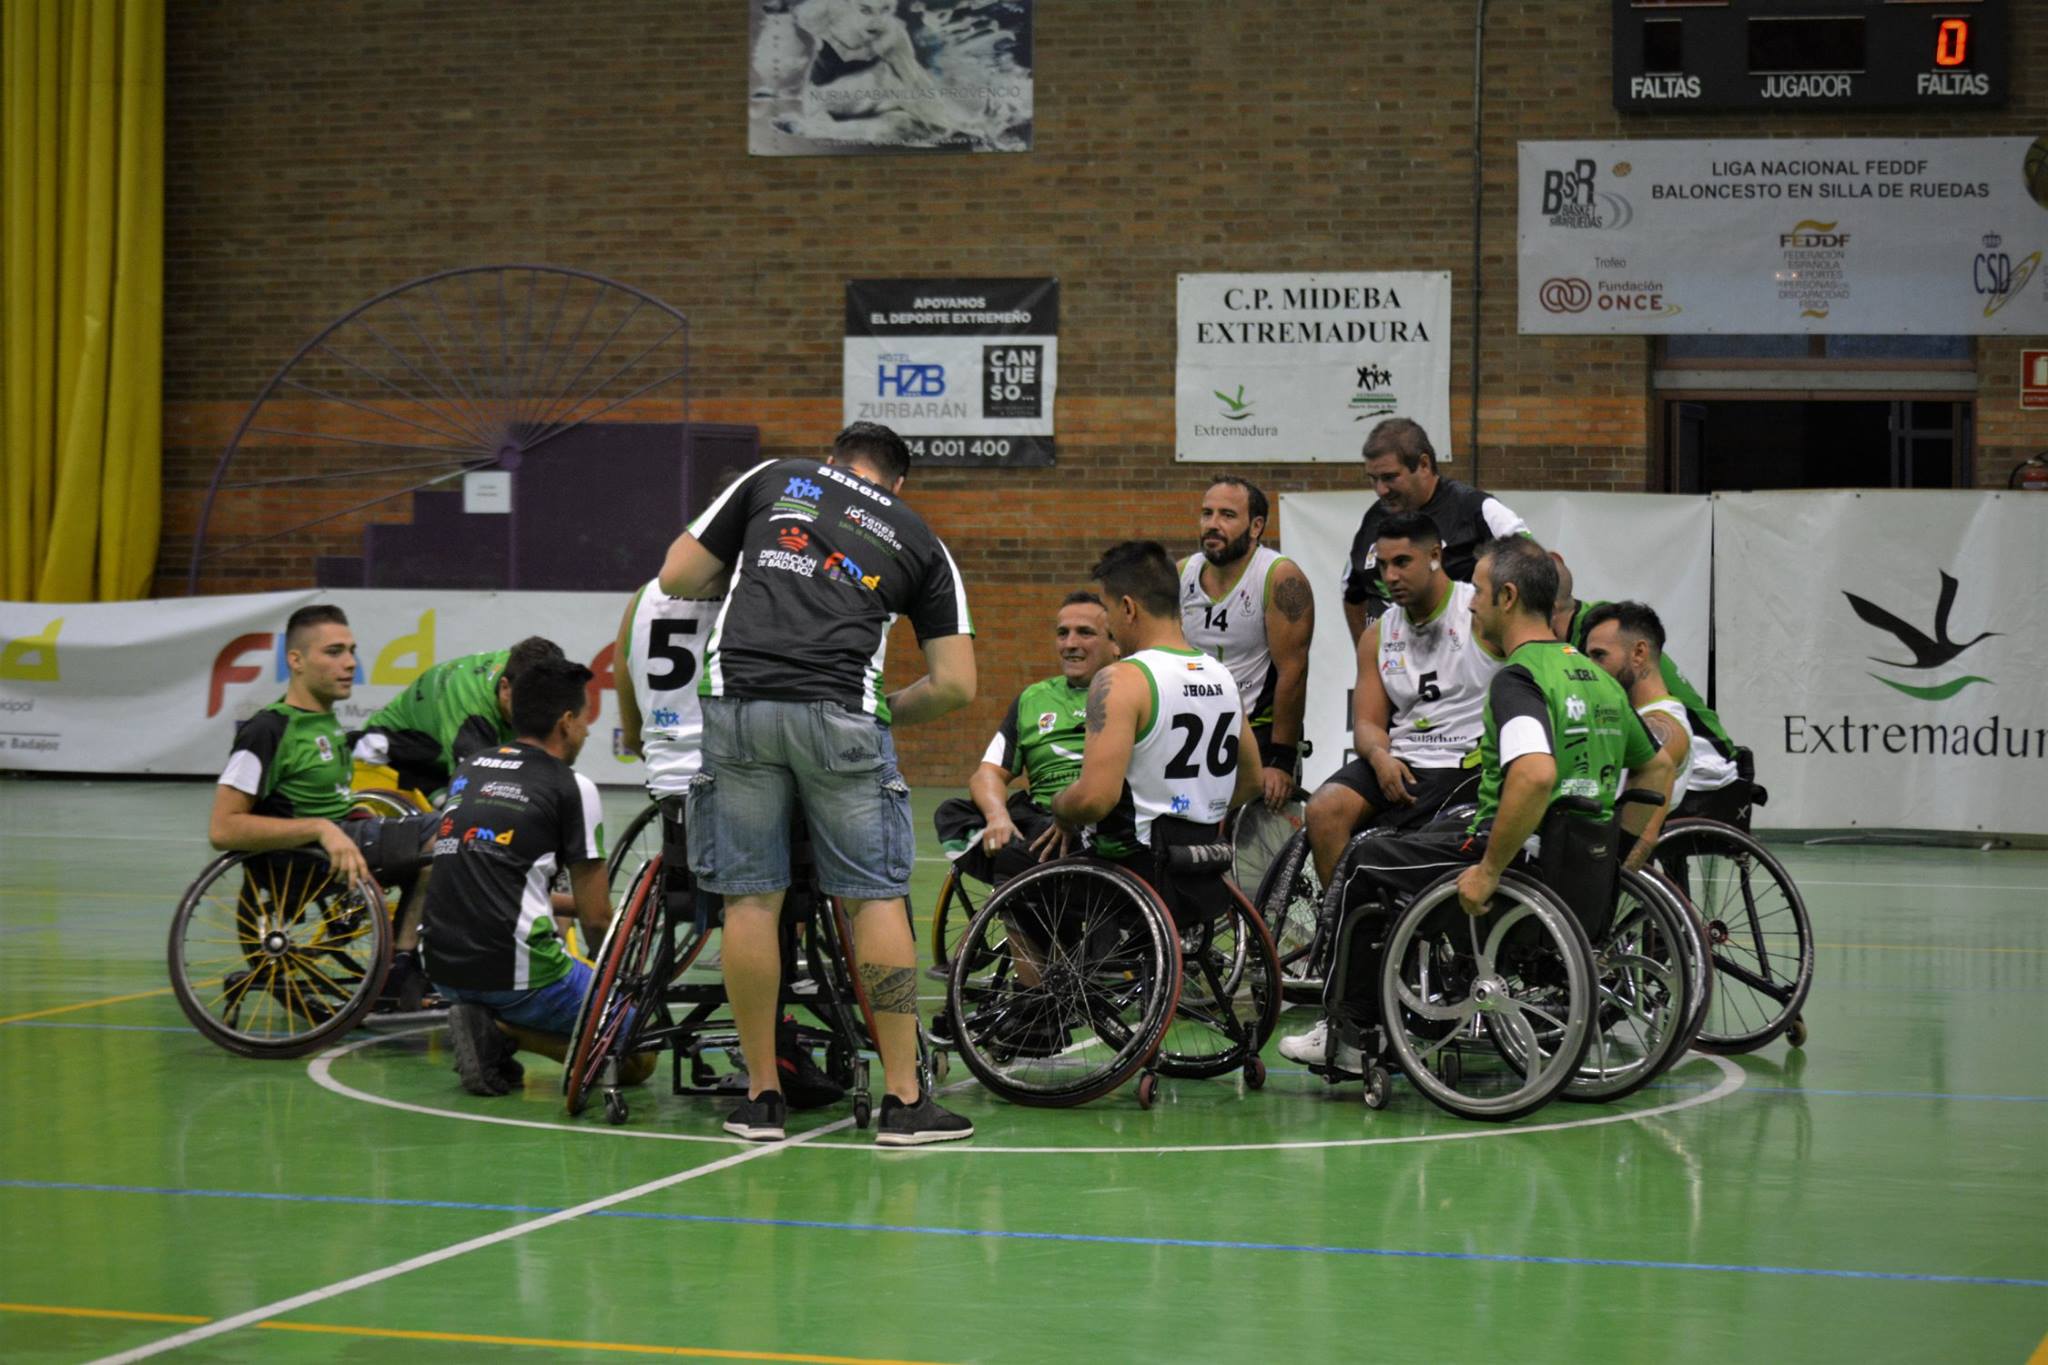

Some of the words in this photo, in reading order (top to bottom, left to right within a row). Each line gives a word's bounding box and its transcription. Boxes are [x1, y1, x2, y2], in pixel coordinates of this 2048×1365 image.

[1936, 19, 1968, 66] 0
[1631, 76, 1701, 99] FALTAS
[1761, 75, 1851, 98] JUGADOR
[1917, 73, 1989, 96] FALTAS
[1712, 162, 1756, 176] LIGA
[1761, 161, 1859, 176] NACIONAL
[1865, 160, 1928, 175] FEDDF
[1652, 184, 1782, 199] BALONCESTO
[1787, 184, 1813, 199] EN
[1819, 183, 1872, 199] SILLA
[1878, 183, 1903, 198] DE
[1910, 182, 1990, 198] RUEDAS
[1780, 233, 1850, 248] FEDDF
[1595, 257, 1626, 269] Trofeo
[1974, 253, 2011, 294] CSD
[1598, 281, 1663, 292] Fundación
[913, 297, 986, 309] APOYAMOS
[1224, 288, 1273, 310] C.P.
[1283, 287, 1402, 310] MIDEBA
[1597, 295, 1663, 311] ONCE
[871, 313, 888, 325] EL
[890, 312, 950, 324] DEPORTE
[952, 310, 1032, 324] EXTREMEÑO
[1197, 321, 1431, 344] EXTREMADURA
[990, 350, 1037, 366] CAN
[878, 365, 946, 398] HZB
[990, 367, 1035, 384] TUE
[858, 399, 968, 419] ZURBARÁN
[1194, 424, 1279, 437] Extremadura
[906, 440, 926, 457] 24
[931, 440, 965, 457] 001
[970, 440, 1010, 457] 400
[817, 466, 892, 507] SERGIO
[759, 550, 818, 568] DIPUTACIÓN
[767, 559, 815, 578] BADAJOZ
[1204, 606, 1229, 632] 14
[647, 619, 699, 691] 5
[1183, 684, 1224, 697] JHOAN
[1418, 671, 1441, 702] 5
[1164, 711, 1239, 779] 26
[472, 757, 524, 770] JORGE
